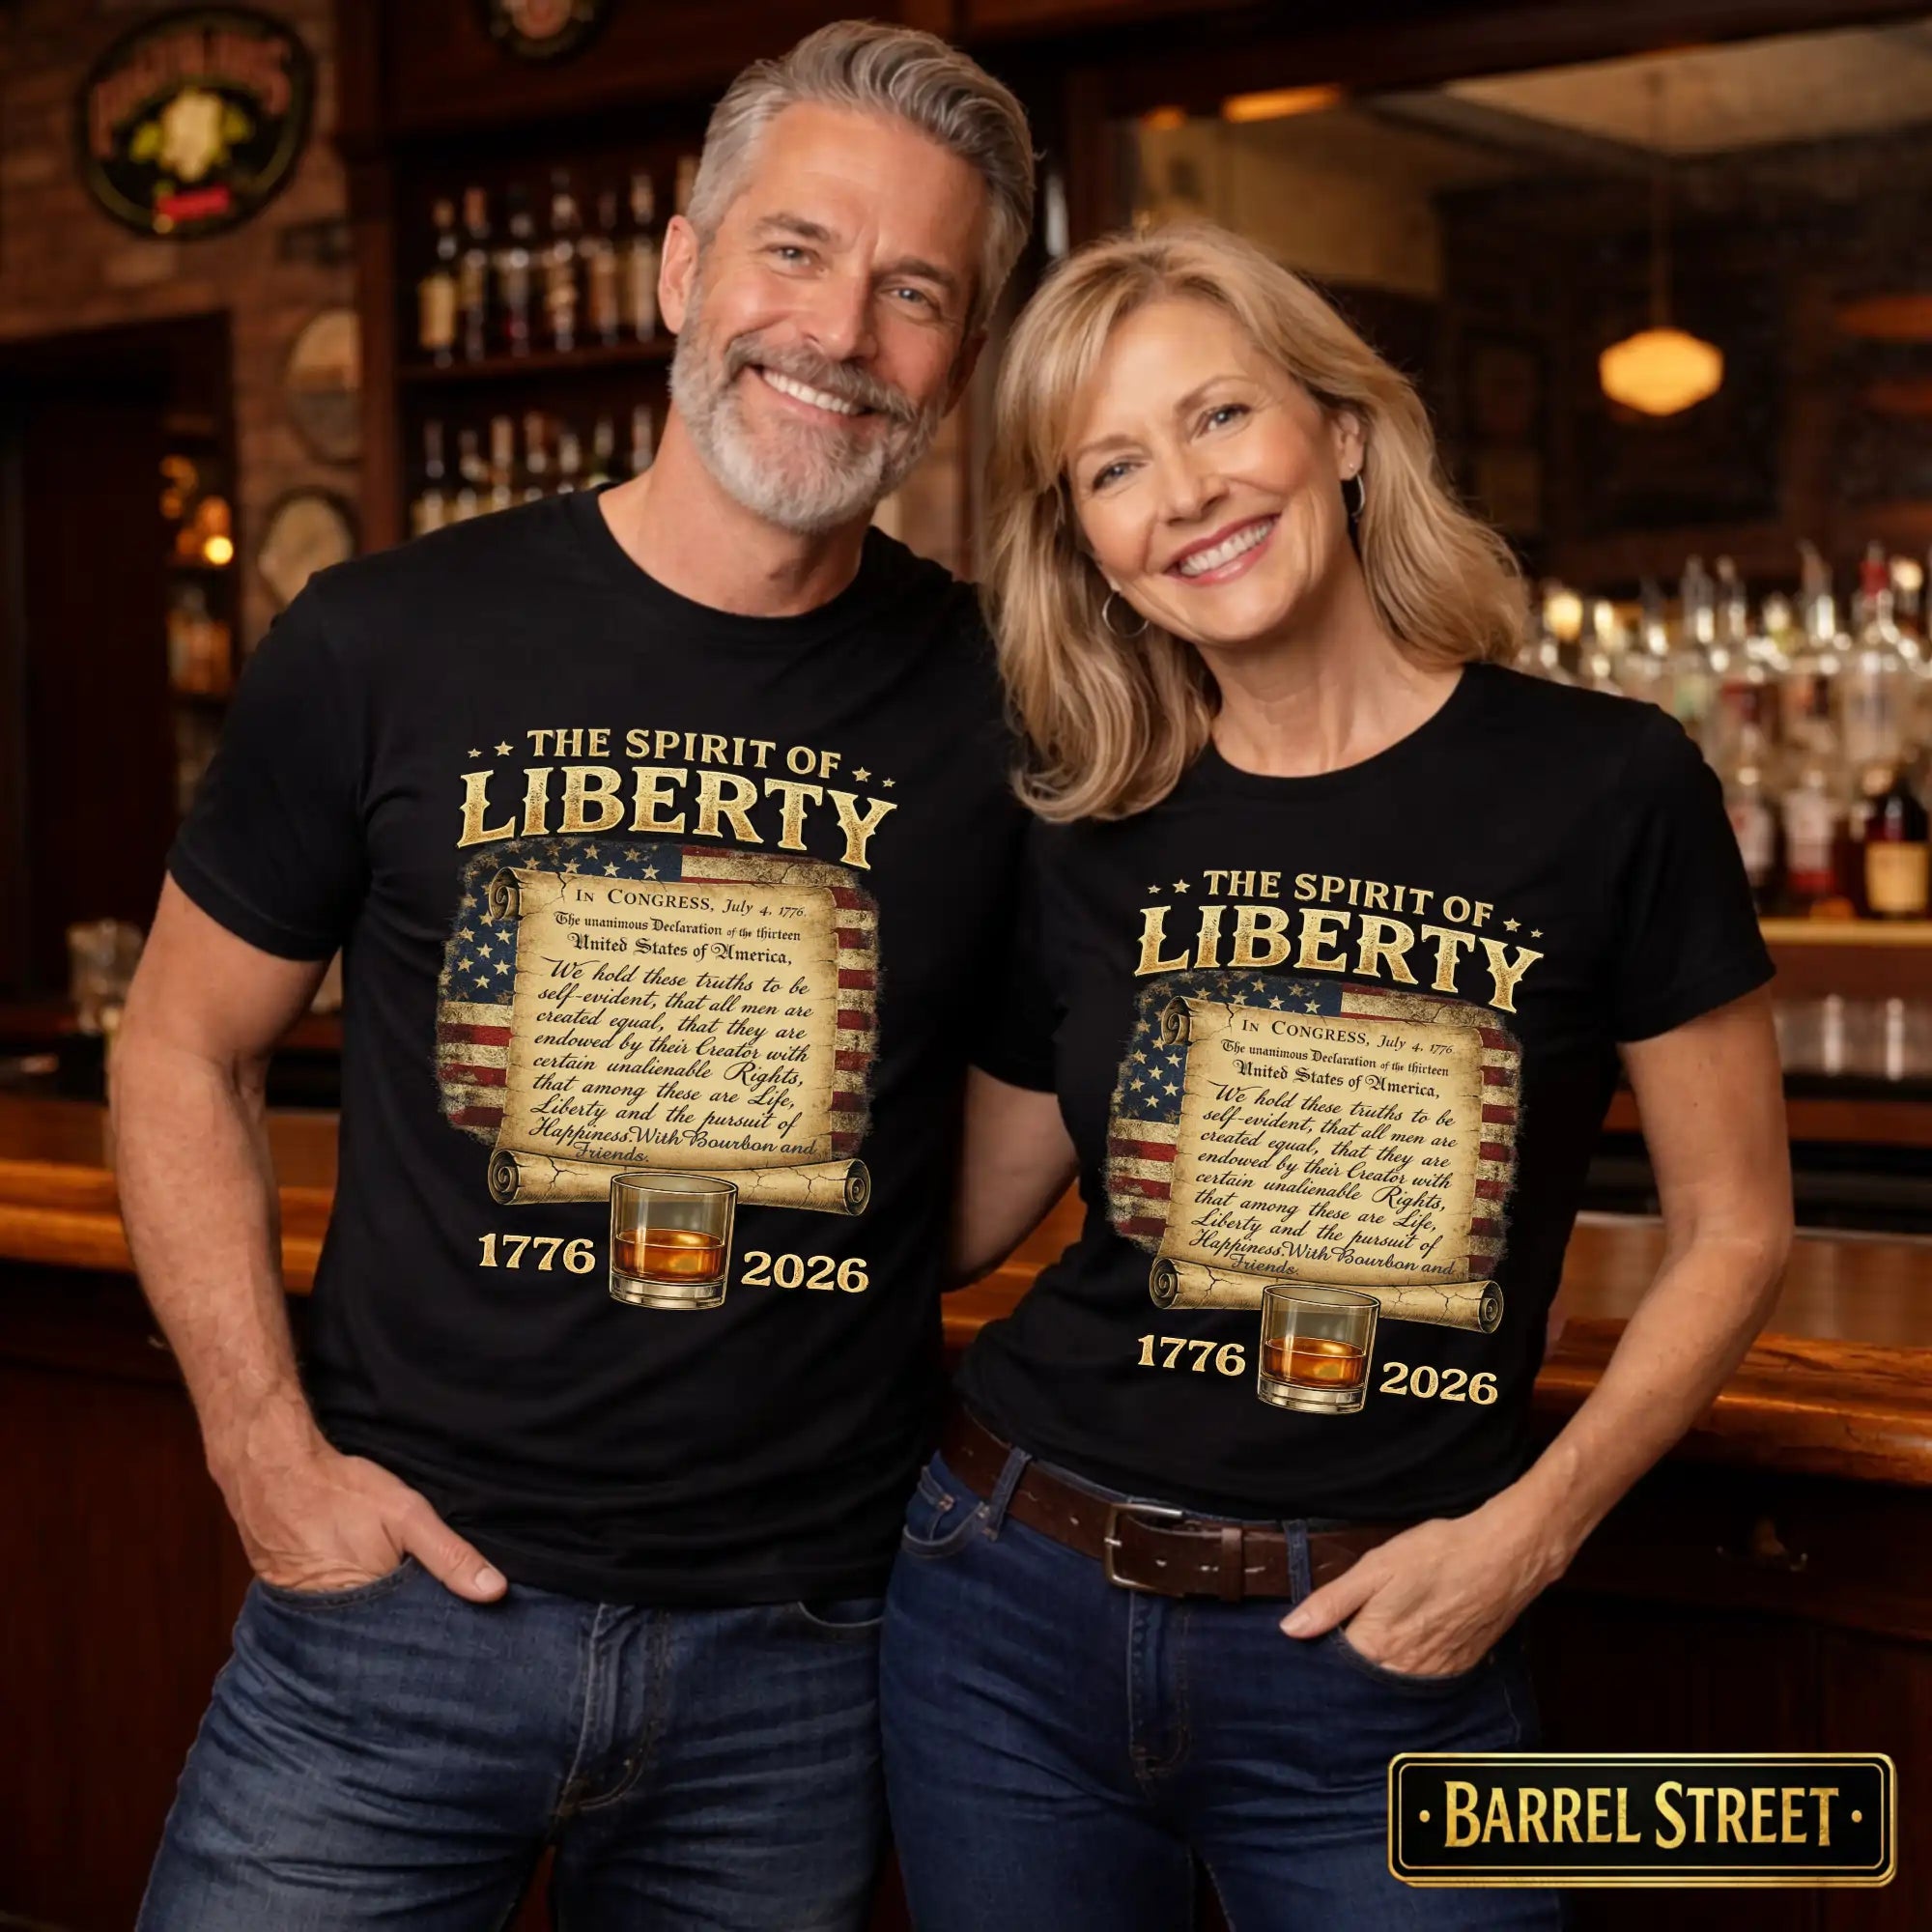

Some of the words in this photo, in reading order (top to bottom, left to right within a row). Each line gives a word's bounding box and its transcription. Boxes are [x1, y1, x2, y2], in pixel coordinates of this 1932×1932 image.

[526, 728, 611, 757] THE
[625, 729, 776, 769] SPIRIT
[785, 746, 841, 779] OF
[456, 765, 897, 869] LIBERTY
[723, 898, 753, 917] July
[1204, 870, 1281, 898] THE
[1294, 872, 1434, 916] SPIRIT
[1442, 895, 1493, 928] OF
[554, 911, 581, 927] The
[584, 916, 648, 930] unanimous
[650, 918, 722, 936] Declaration
[726, 927, 737, 938] of
[739, 927, 752, 938] the
[756, 927, 801, 942] thirteen
[567, 932, 628, 952] United
[635, 938, 687, 956] States
[694, 944, 709, 963] of
[710, 942, 792, 966] America,
[1134, 904, 1544, 1014] LIBERTY
[540, 955, 601, 980] We
[592, 963, 640, 982] hold
[641, 967, 688, 987] these
[696, 972, 753, 991] truths
[762, 977, 782, 993] to
[789, 976, 810, 995] be
[538, 982, 660, 1009] self-evident,
[665, 991, 707, 1009] that
[709, 994, 736, 1012] all
[741, 1004, 783, 1016] men
[784, 1006, 814, 1017] are
[534, 1028, 613, 1049] endowed
[619, 1032, 642, 1058] by
[648, 1036, 694, 1055] their
[696, 1037, 761, 1059] Creator
[766, 1043, 810, 1063] with
[536, 1008, 607, 1026] created
[609, 1011, 667, 1040] equal,
[677, 1014, 724, 1034] that
[725, 1018, 769, 1046] they
[775, 1027, 807, 1039] are
[1378, 1035, 1406, 1051] July
[533, 1053, 597, 1070] certain
[607, 1058, 713, 1079] unalienable
[724, 1062, 804, 1092] Rights,
[1221, 1038, 1245, 1054] The
[1249, 1044, 1308, 1061] unanimous
[1310, 1047, 1377, 1068] Declaration
[1380, 1061, 1389, 1071] of
[1391, 1062, 1404, 1071] the
[1407, 1062, 1449, 1077] thirteen
[532, 1073, 581, 1092] that
[582, 1083, 647, 1106] among
[656, 1081, 702, 1101] these
[709, 1092, 741, 1103] are
[748, 1086, 795, 1119] Life,
[1233, 1059, 1288, 1079] United
[1294, 1066, 1344, 1086] States
[1349, 1075, 1363, 1093] of
[1365, 1074, 1439, 1099] America,
[530, 1094, 609, 1126] Liberty
[615, 1102, 660, 1121] and
[666, 1106, 696, 1123] the
[696, 1111, 773, 1135] pursuit
[778, 1113, 804, 1140] of
[1208, 1080, 1263, 1102] We
[1254, 1089, 1298, 1109] hold
[1301, 1094, 1344, 1114] these
[1350, 1101, 1404, 1122] truths
[1411, 1108, 1430, 1123] to
[1435, 1109, 1457, 1127] be
[683, 1129, 779, 1152] Bourbon
[780, 1139, 818, 1156] and
[1203, 1105, 1314, 1134] self-evident,
[1320, 1119, 1362, 1136] that
[1361, 1122, 1389, 1141] all
[1391, 1132, 1430, 1144] men
[1431, 1136, 1458, 1149] are
[1198, 1148, 1275, 1170] endowed
[1276, 1155, 1299, 1180] by
[1304, 1159, 1347, 1178] their
[1347, 1161, 1407, 1184] Creator
[1412, 1172, 1454, 1188] with
[1200, 1129, 1266, 1147] created
[1267, 1136, 1321, 1163] equal,
[1330, 1140, 1374, 1159] that
[1376, 1146, 1415, 1172] they
[1421, 1156, 1451, 1168] are
[1196, 1171, 1256, 1188] certain
[1264, 1179, 1362, 1201] unalienable
[1372, 1185, 1445, 1214] Rights,
[1191, 1208, 1264, 1240] Liberty
[1270, 1221, 1311, 1237] and
[1316, 1224, 1344, 1241] the
[1344, 1230, 1416, 1252] pursuit
[1419, 1235, 1444, 1260] of
[1194, 1189, 1239, 1207] that
[1240, 1201, 1301, 1222] among
[1308, 1202, 1351, 1219] these
[1358, 1213, 1386, 1224] are
[1392, 1209, 1436, 1238] Life,
[478, 1233, 596, 1274] 1776
[741, 1251, 869, 1293] 2026
[1331, 1246, 1420, 1270] Bourbon
[1421, 1260, 1456, 1276] and
[1137, 1335, 1247, 1377] 1776
[1379, 1362, 1498, 1405] 2026
